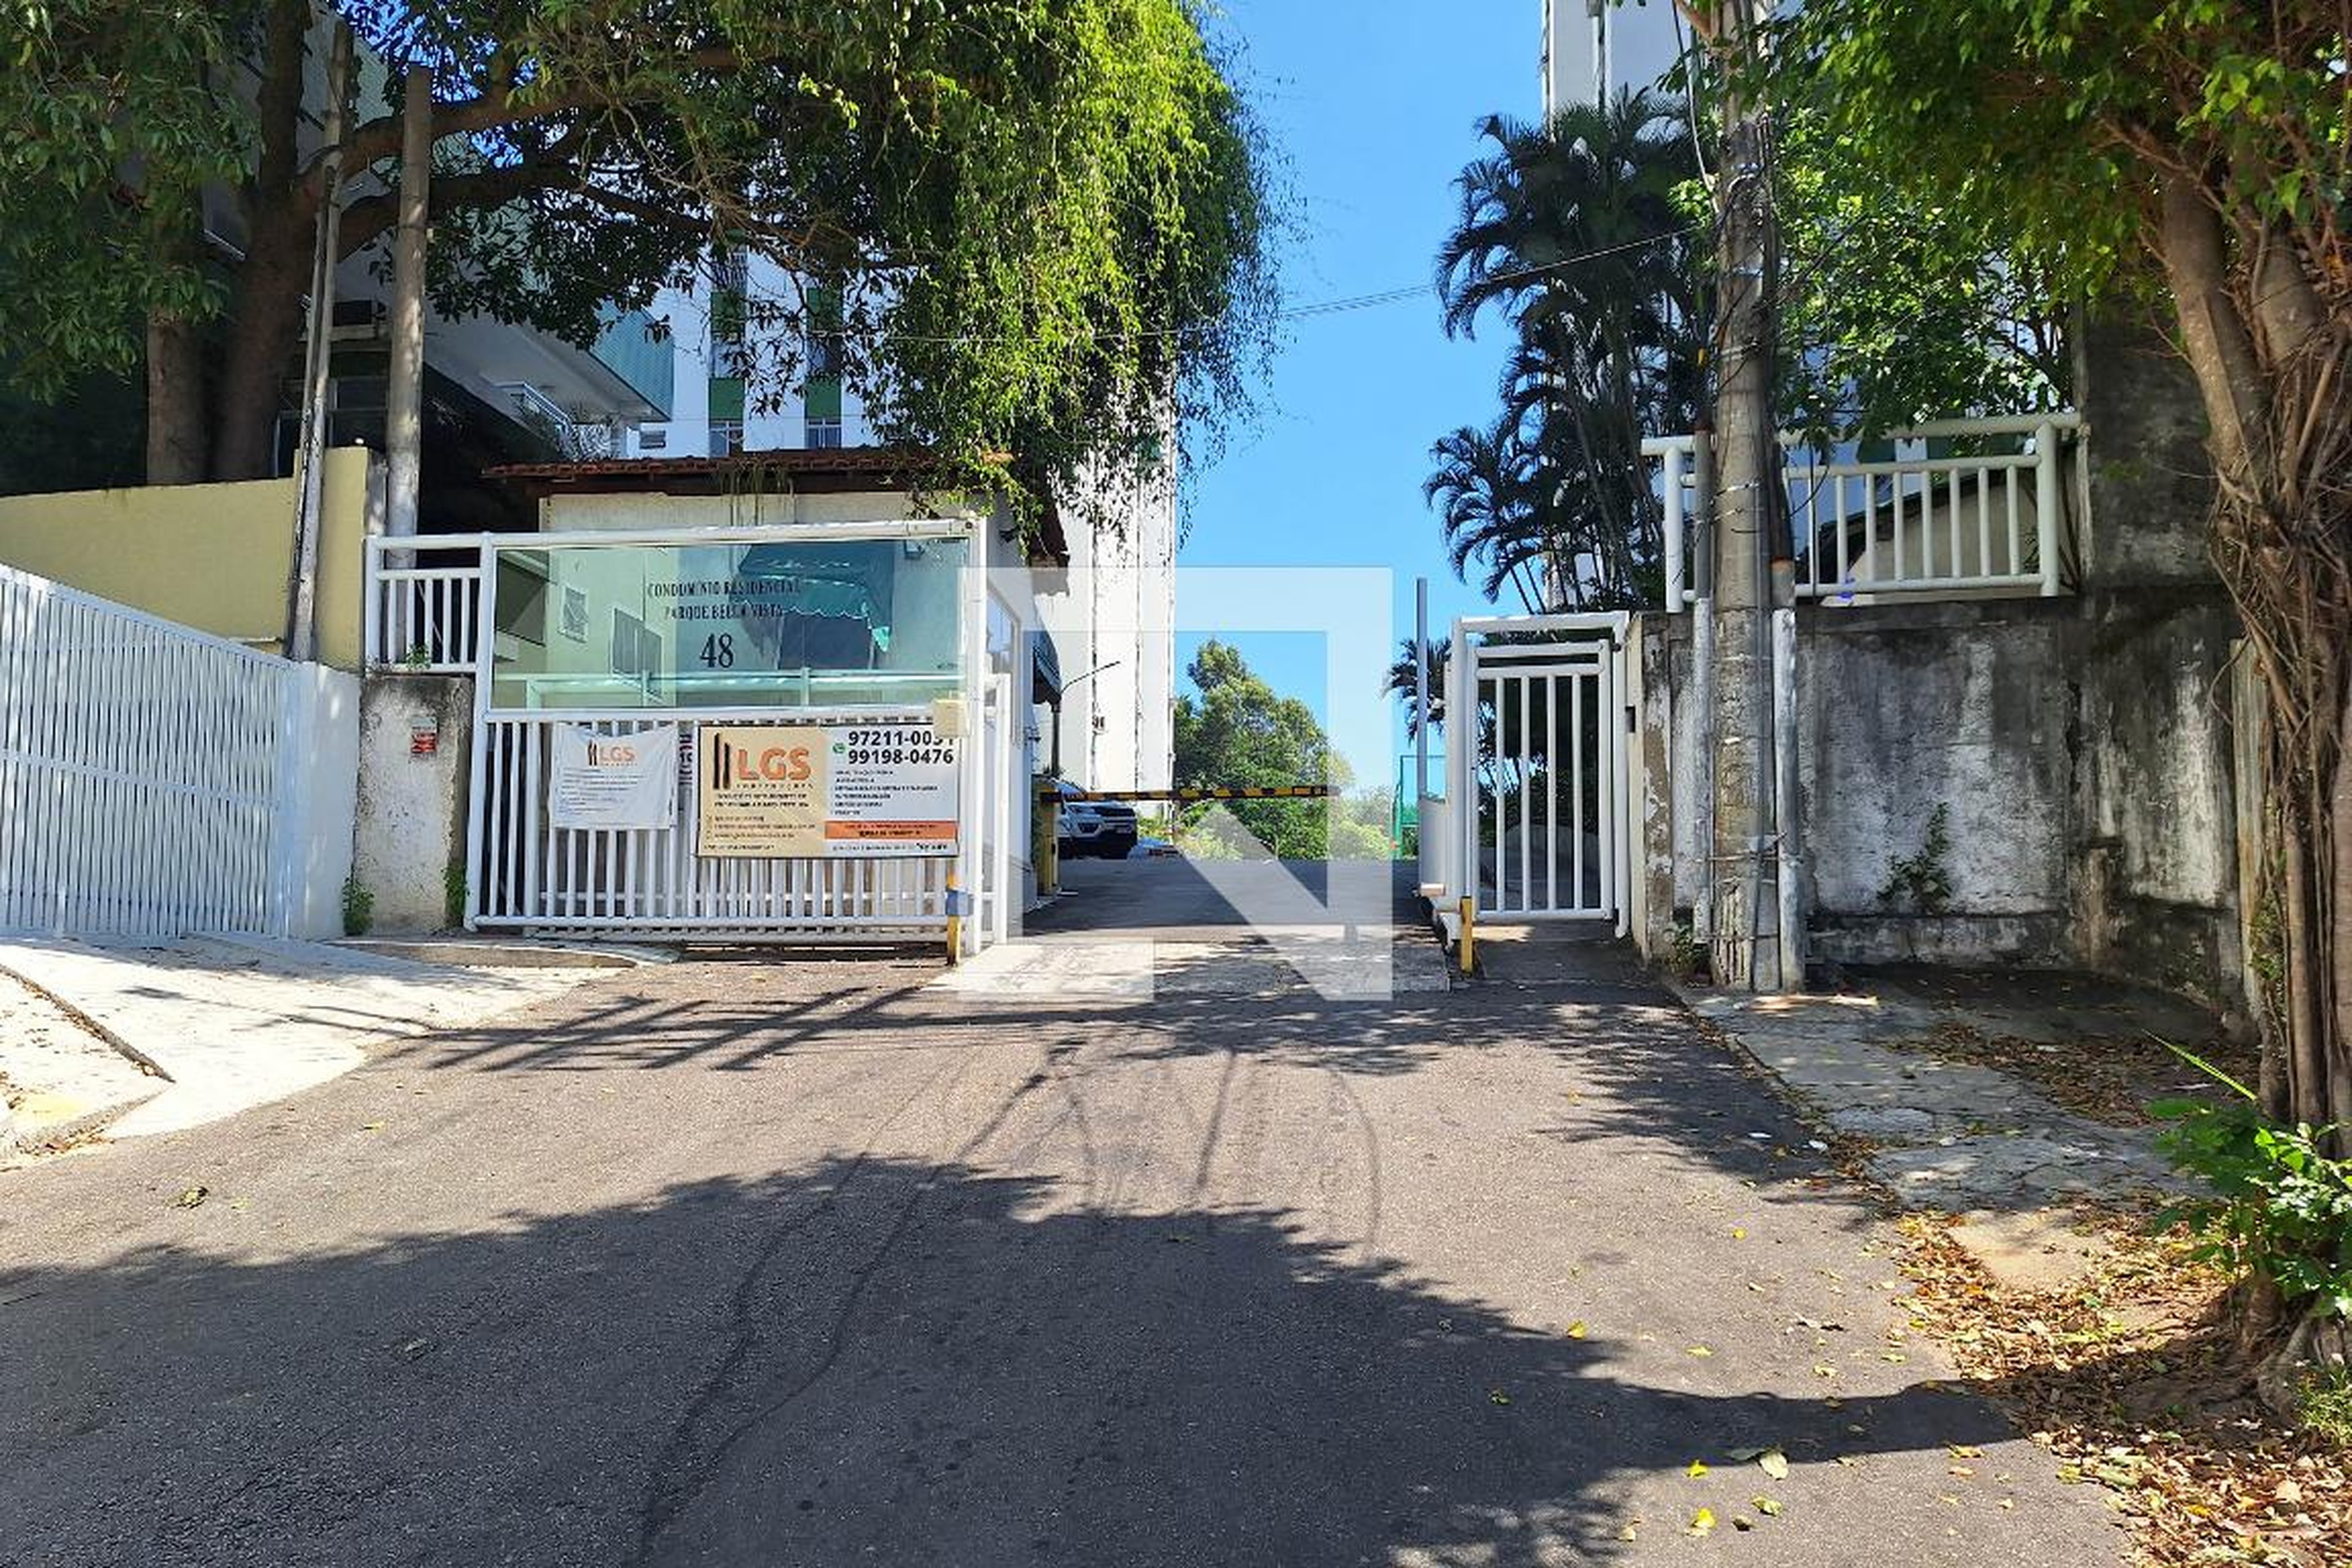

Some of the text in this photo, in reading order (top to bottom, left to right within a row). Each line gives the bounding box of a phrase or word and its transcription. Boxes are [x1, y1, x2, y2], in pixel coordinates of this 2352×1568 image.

[724, 579, 801, 595] RESIDENCIAL
[665, 604, 783, 620] PARQUE BELLA VISTA
[700, 633, 734, 668] 48
[600, 745, 635, 762] LGS
[848, 749, 954, 764] 99198-0476
[737, 747, 811, 780] LGS
